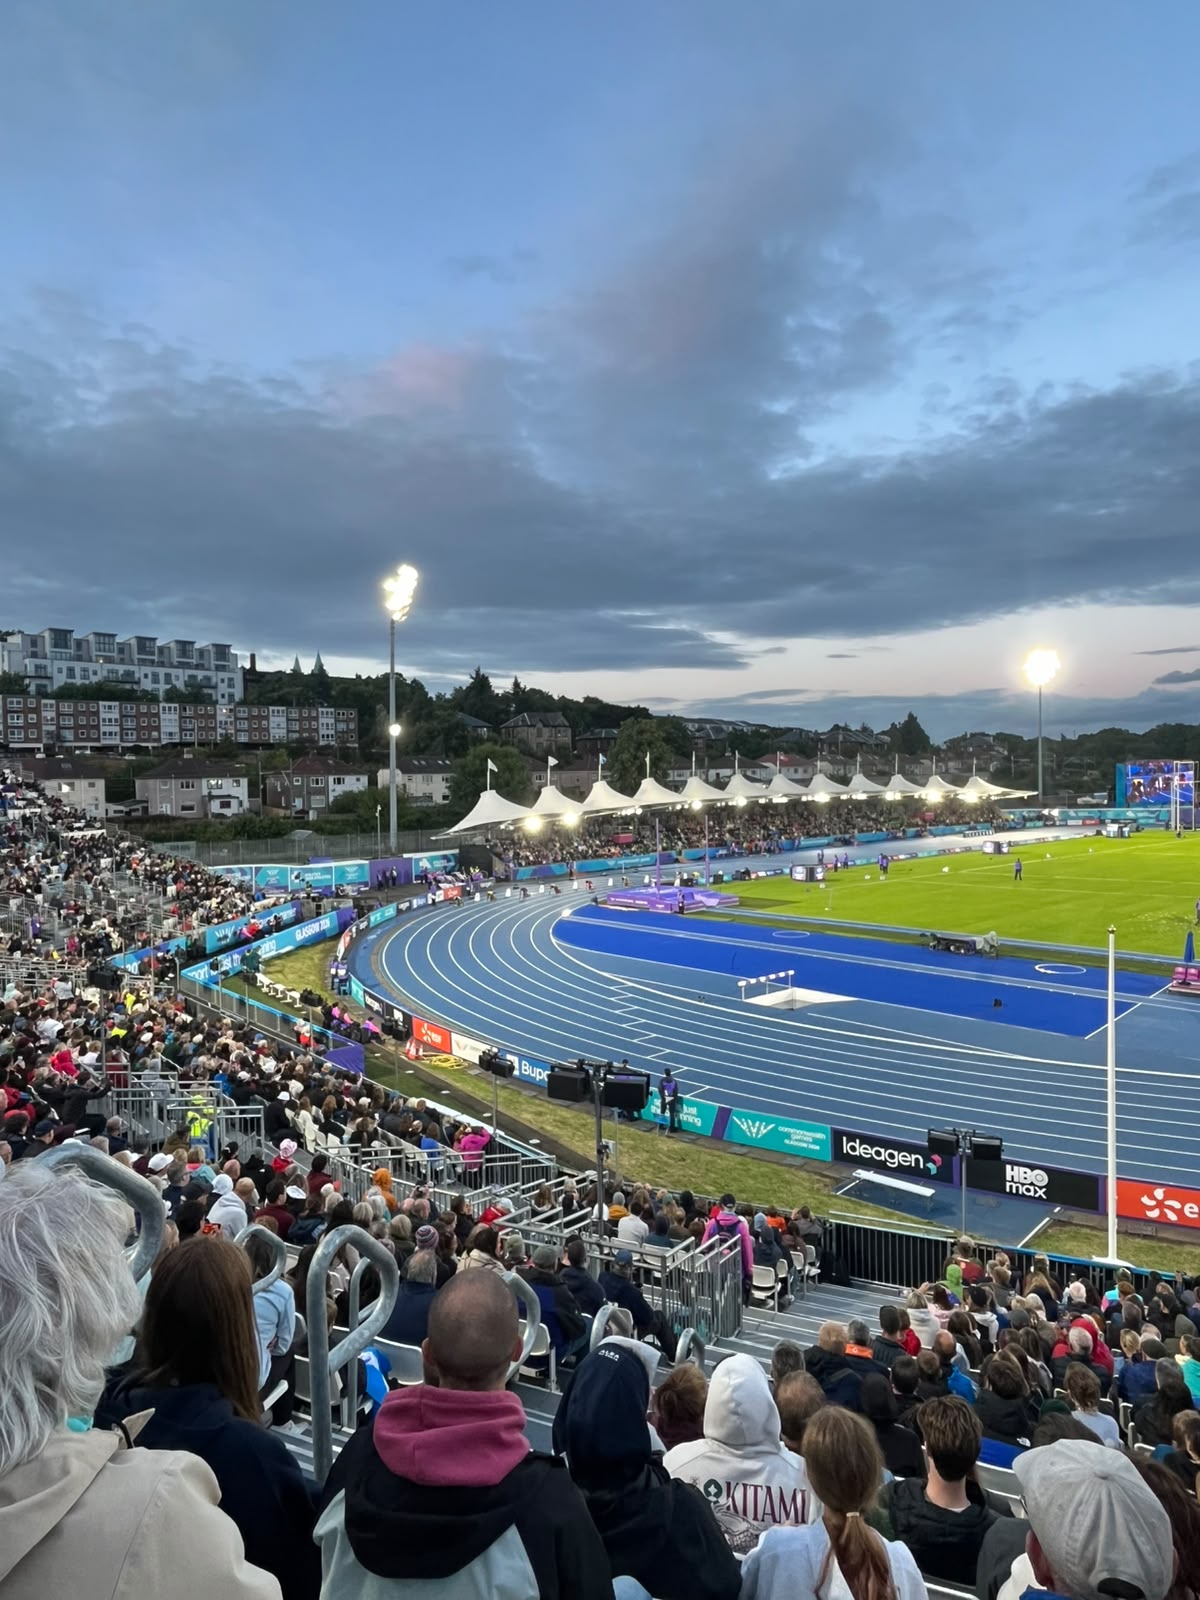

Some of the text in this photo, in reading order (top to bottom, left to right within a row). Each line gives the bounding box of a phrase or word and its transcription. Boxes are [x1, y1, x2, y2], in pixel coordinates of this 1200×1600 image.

[842, 1136, 924, 1169] Ideagen
[1005, 1164, 1049, 1187] HBO
[1005, 1181, 1047, 1200] max
[725, 1481, 808, 1525] KITAMI
